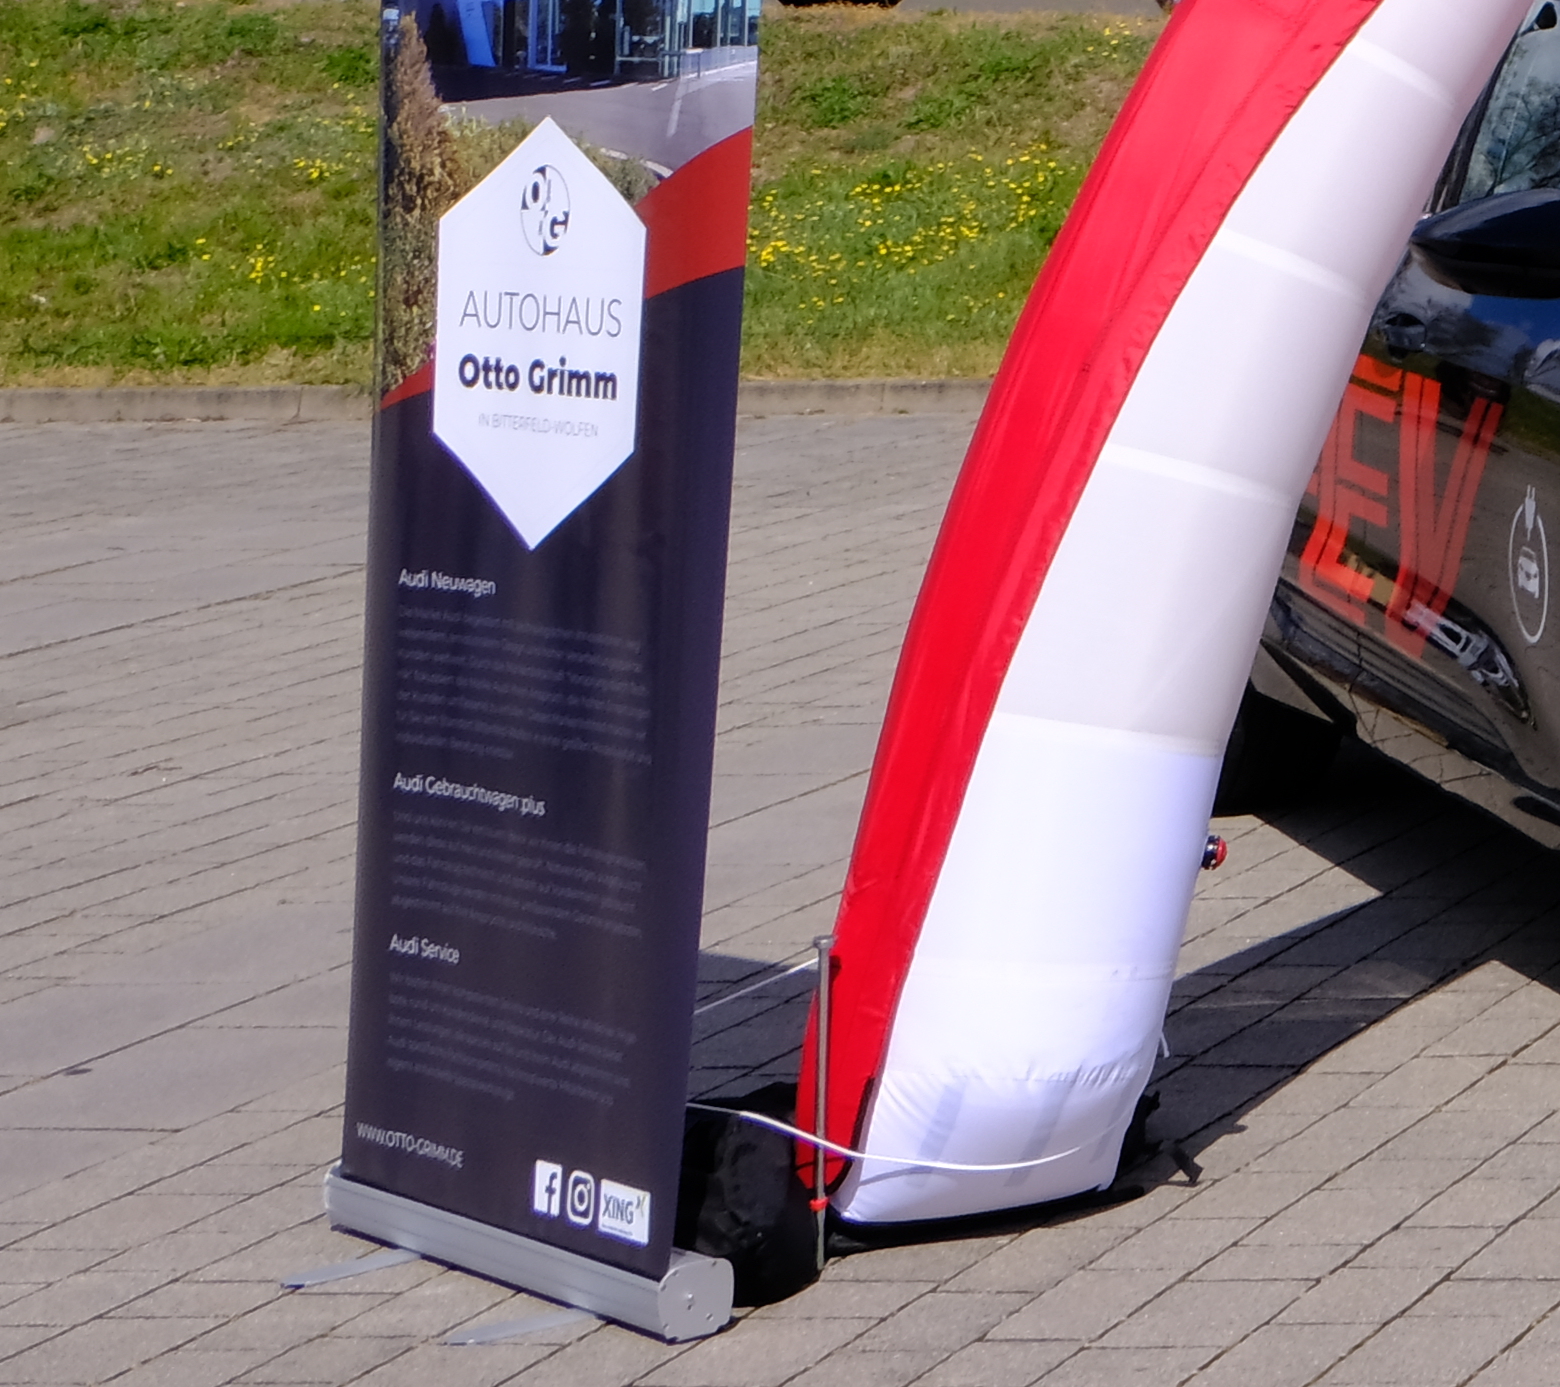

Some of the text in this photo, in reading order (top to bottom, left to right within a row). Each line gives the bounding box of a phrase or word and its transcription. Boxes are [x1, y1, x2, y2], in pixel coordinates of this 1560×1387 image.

[459, 290, 622, 338] AUTOHAUS
[458, 353, 617, 401] Otto Grimm
[398, 568, 496, 598] Audi Neuwagen
[393, 772, 423, 792] Audi
[389, 933, 460, 964] Audi Service
[602, 1193, 633, 1224] XING
